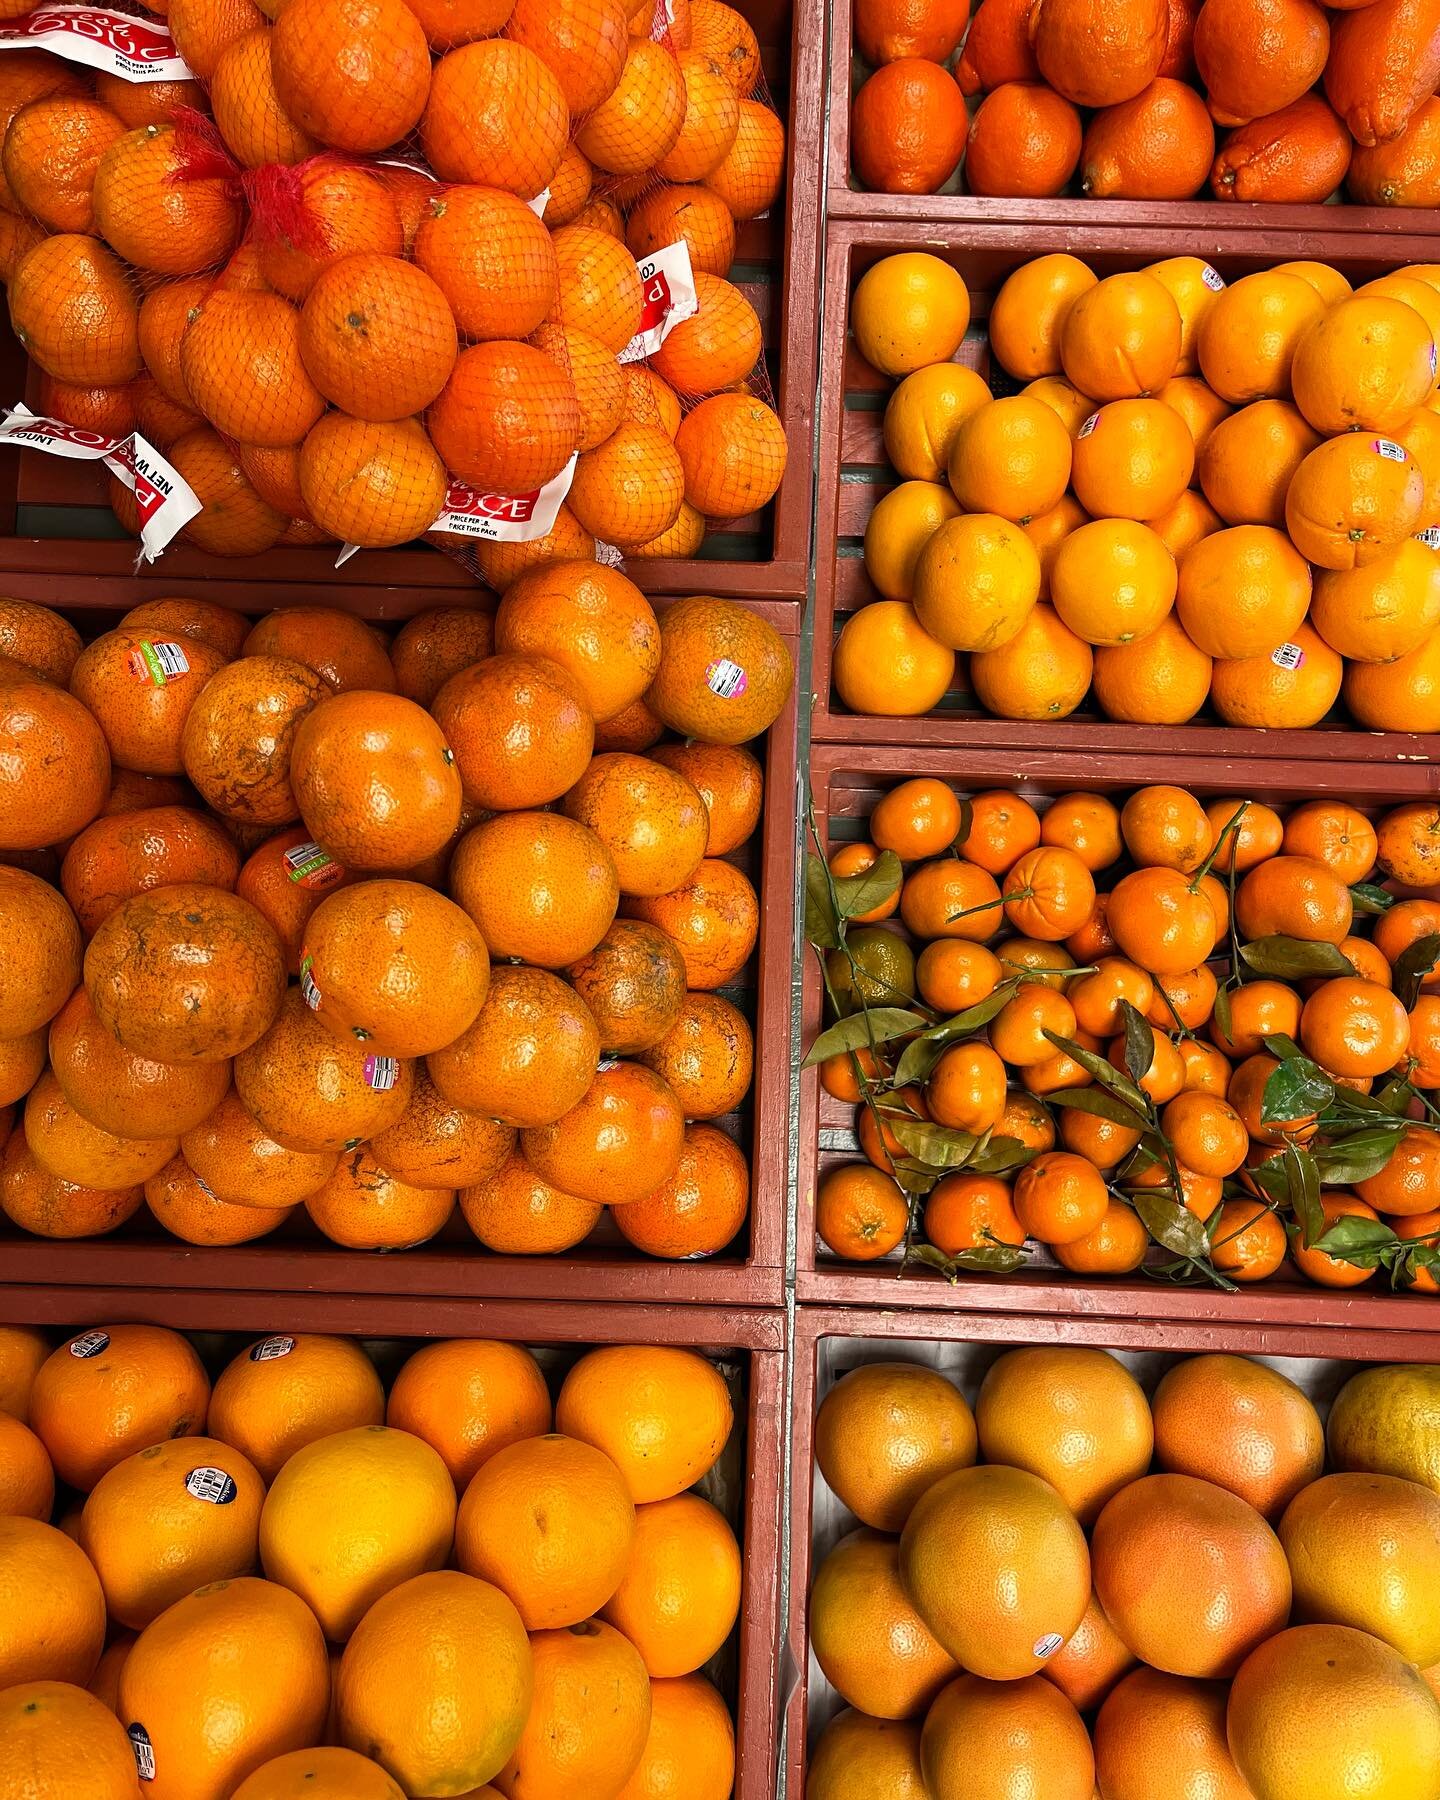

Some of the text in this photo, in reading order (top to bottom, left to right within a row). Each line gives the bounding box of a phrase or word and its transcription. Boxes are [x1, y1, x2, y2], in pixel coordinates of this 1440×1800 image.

[149, 470, 174, 496] NET
[450, 514, 468, 523] PRICE
[468, 515, 480, 524] PER
[448, 522, 498, 537] PRICE THIS PACK
[193, 1471, 205, 1490] 3107
